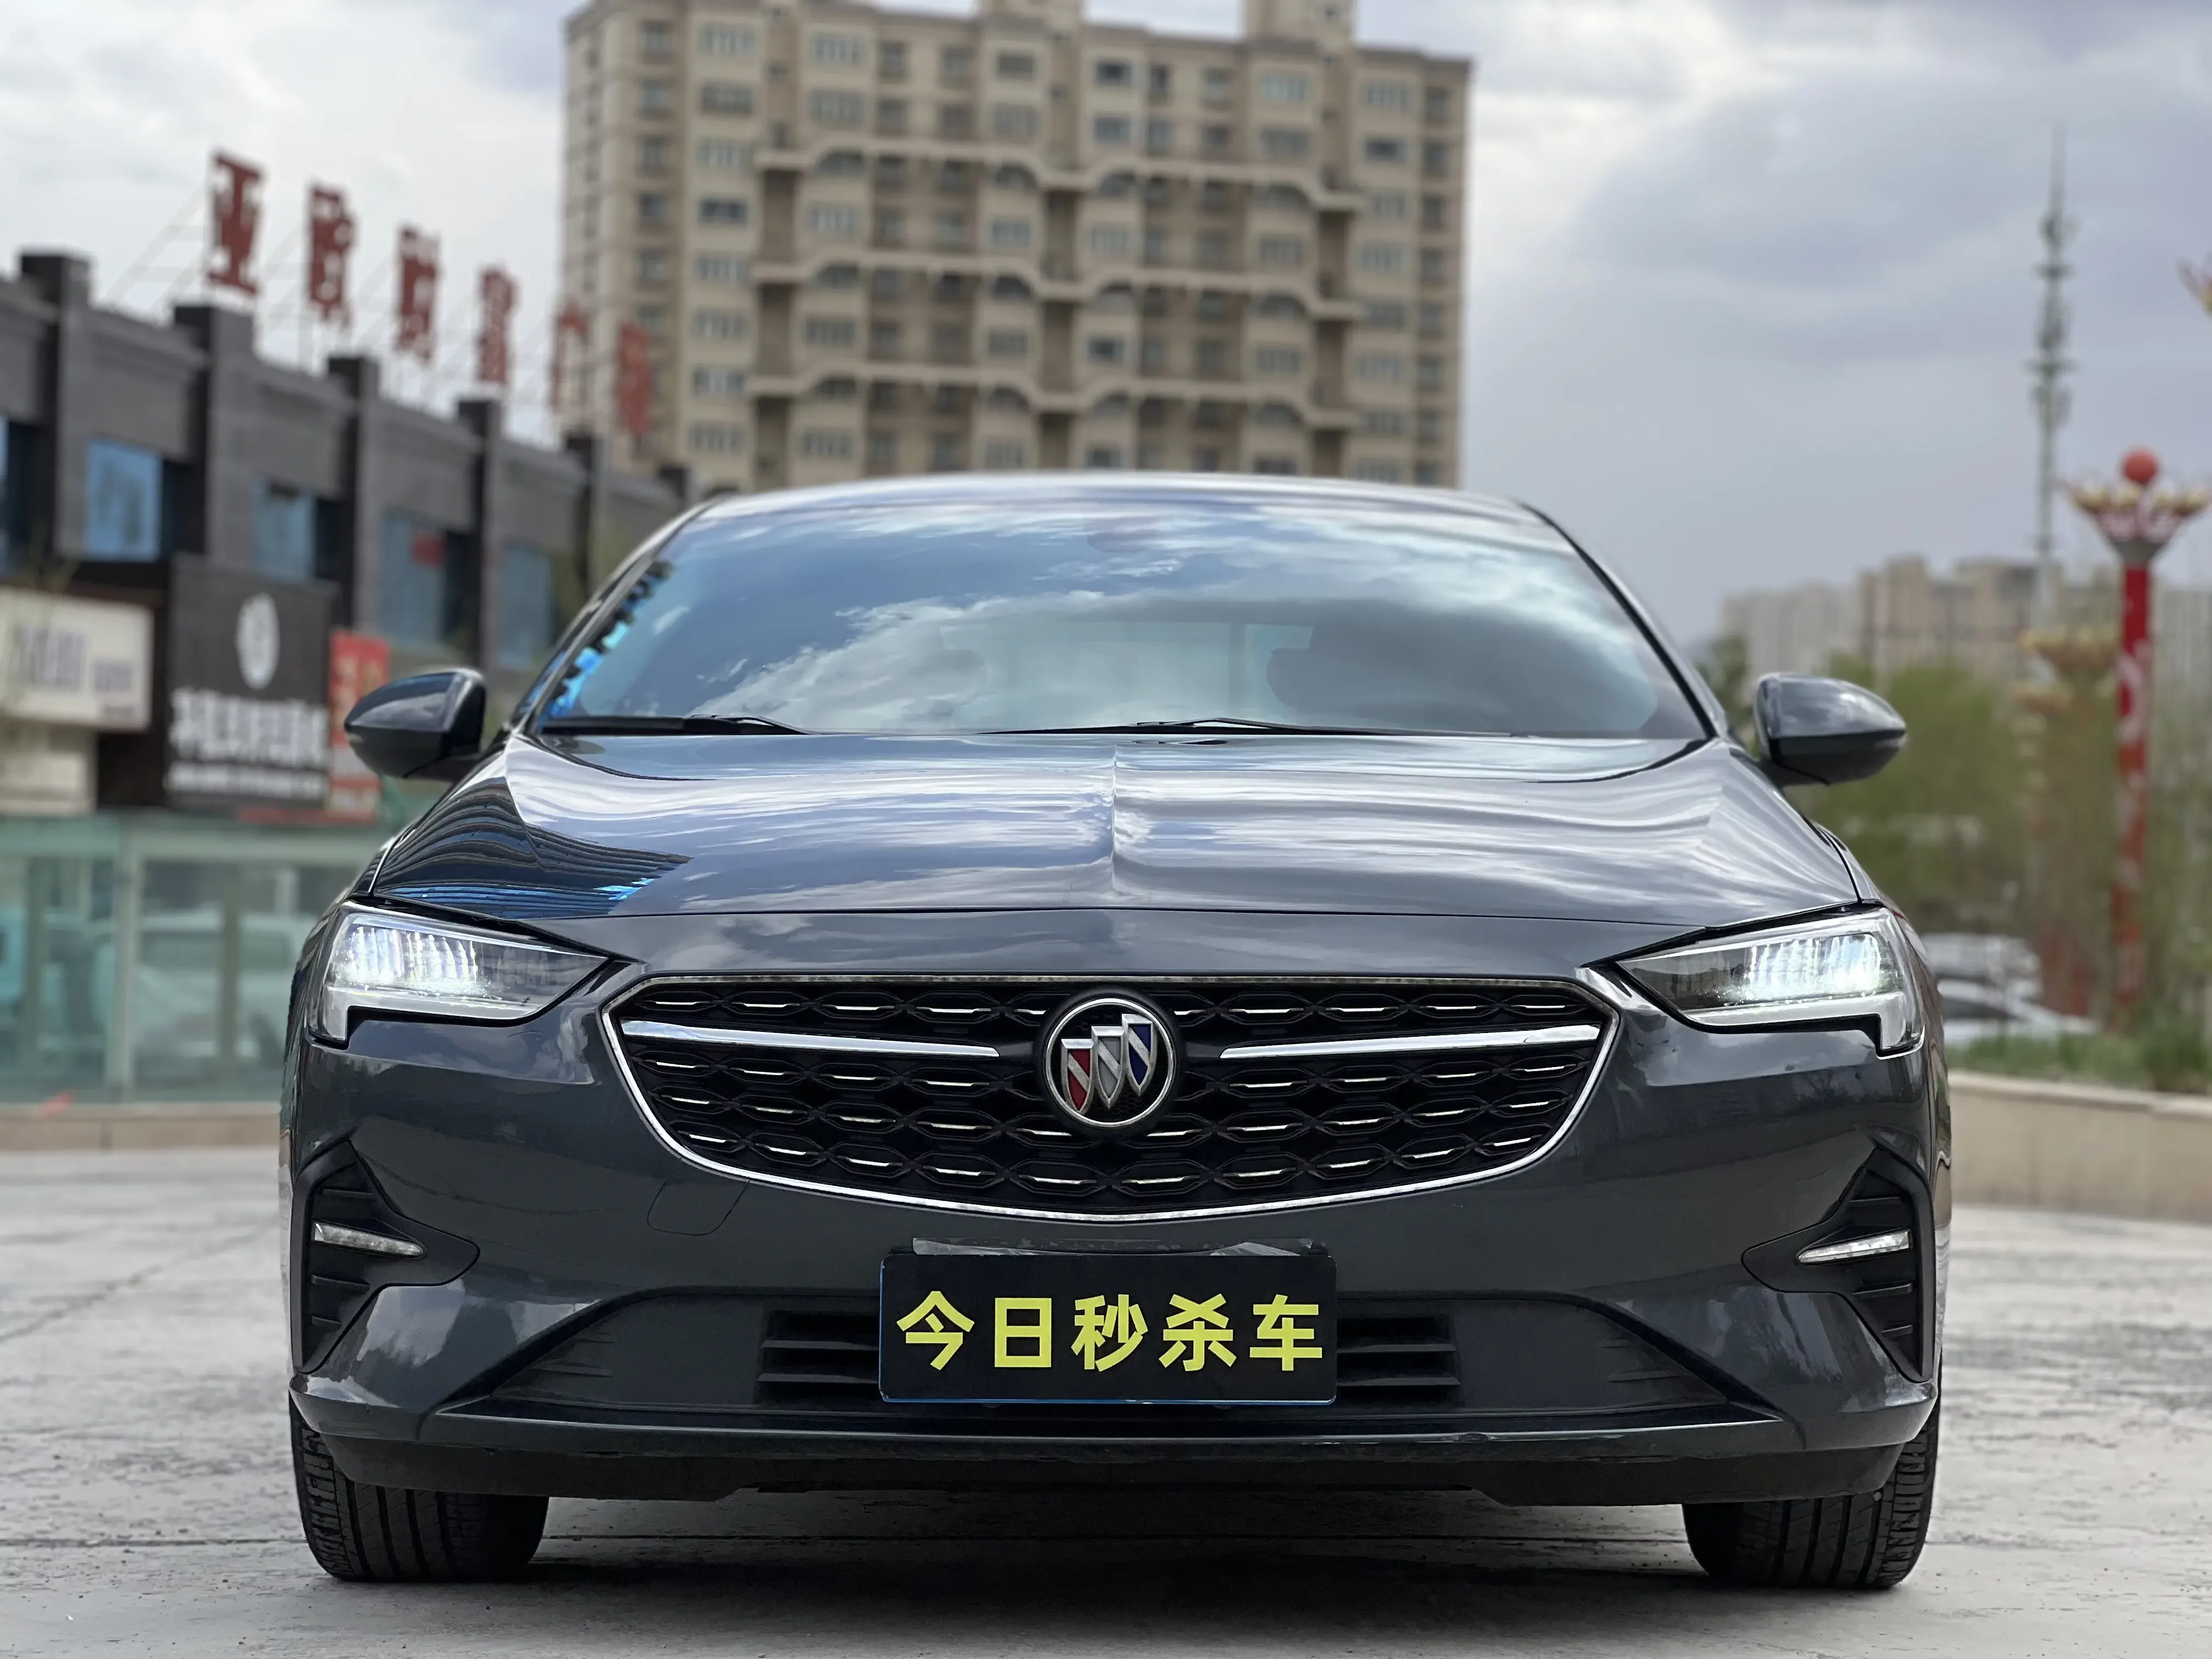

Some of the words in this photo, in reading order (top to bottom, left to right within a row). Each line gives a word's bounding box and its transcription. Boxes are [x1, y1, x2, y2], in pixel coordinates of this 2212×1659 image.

[896, 1290, 1323, 1372] 今日秒杀车
